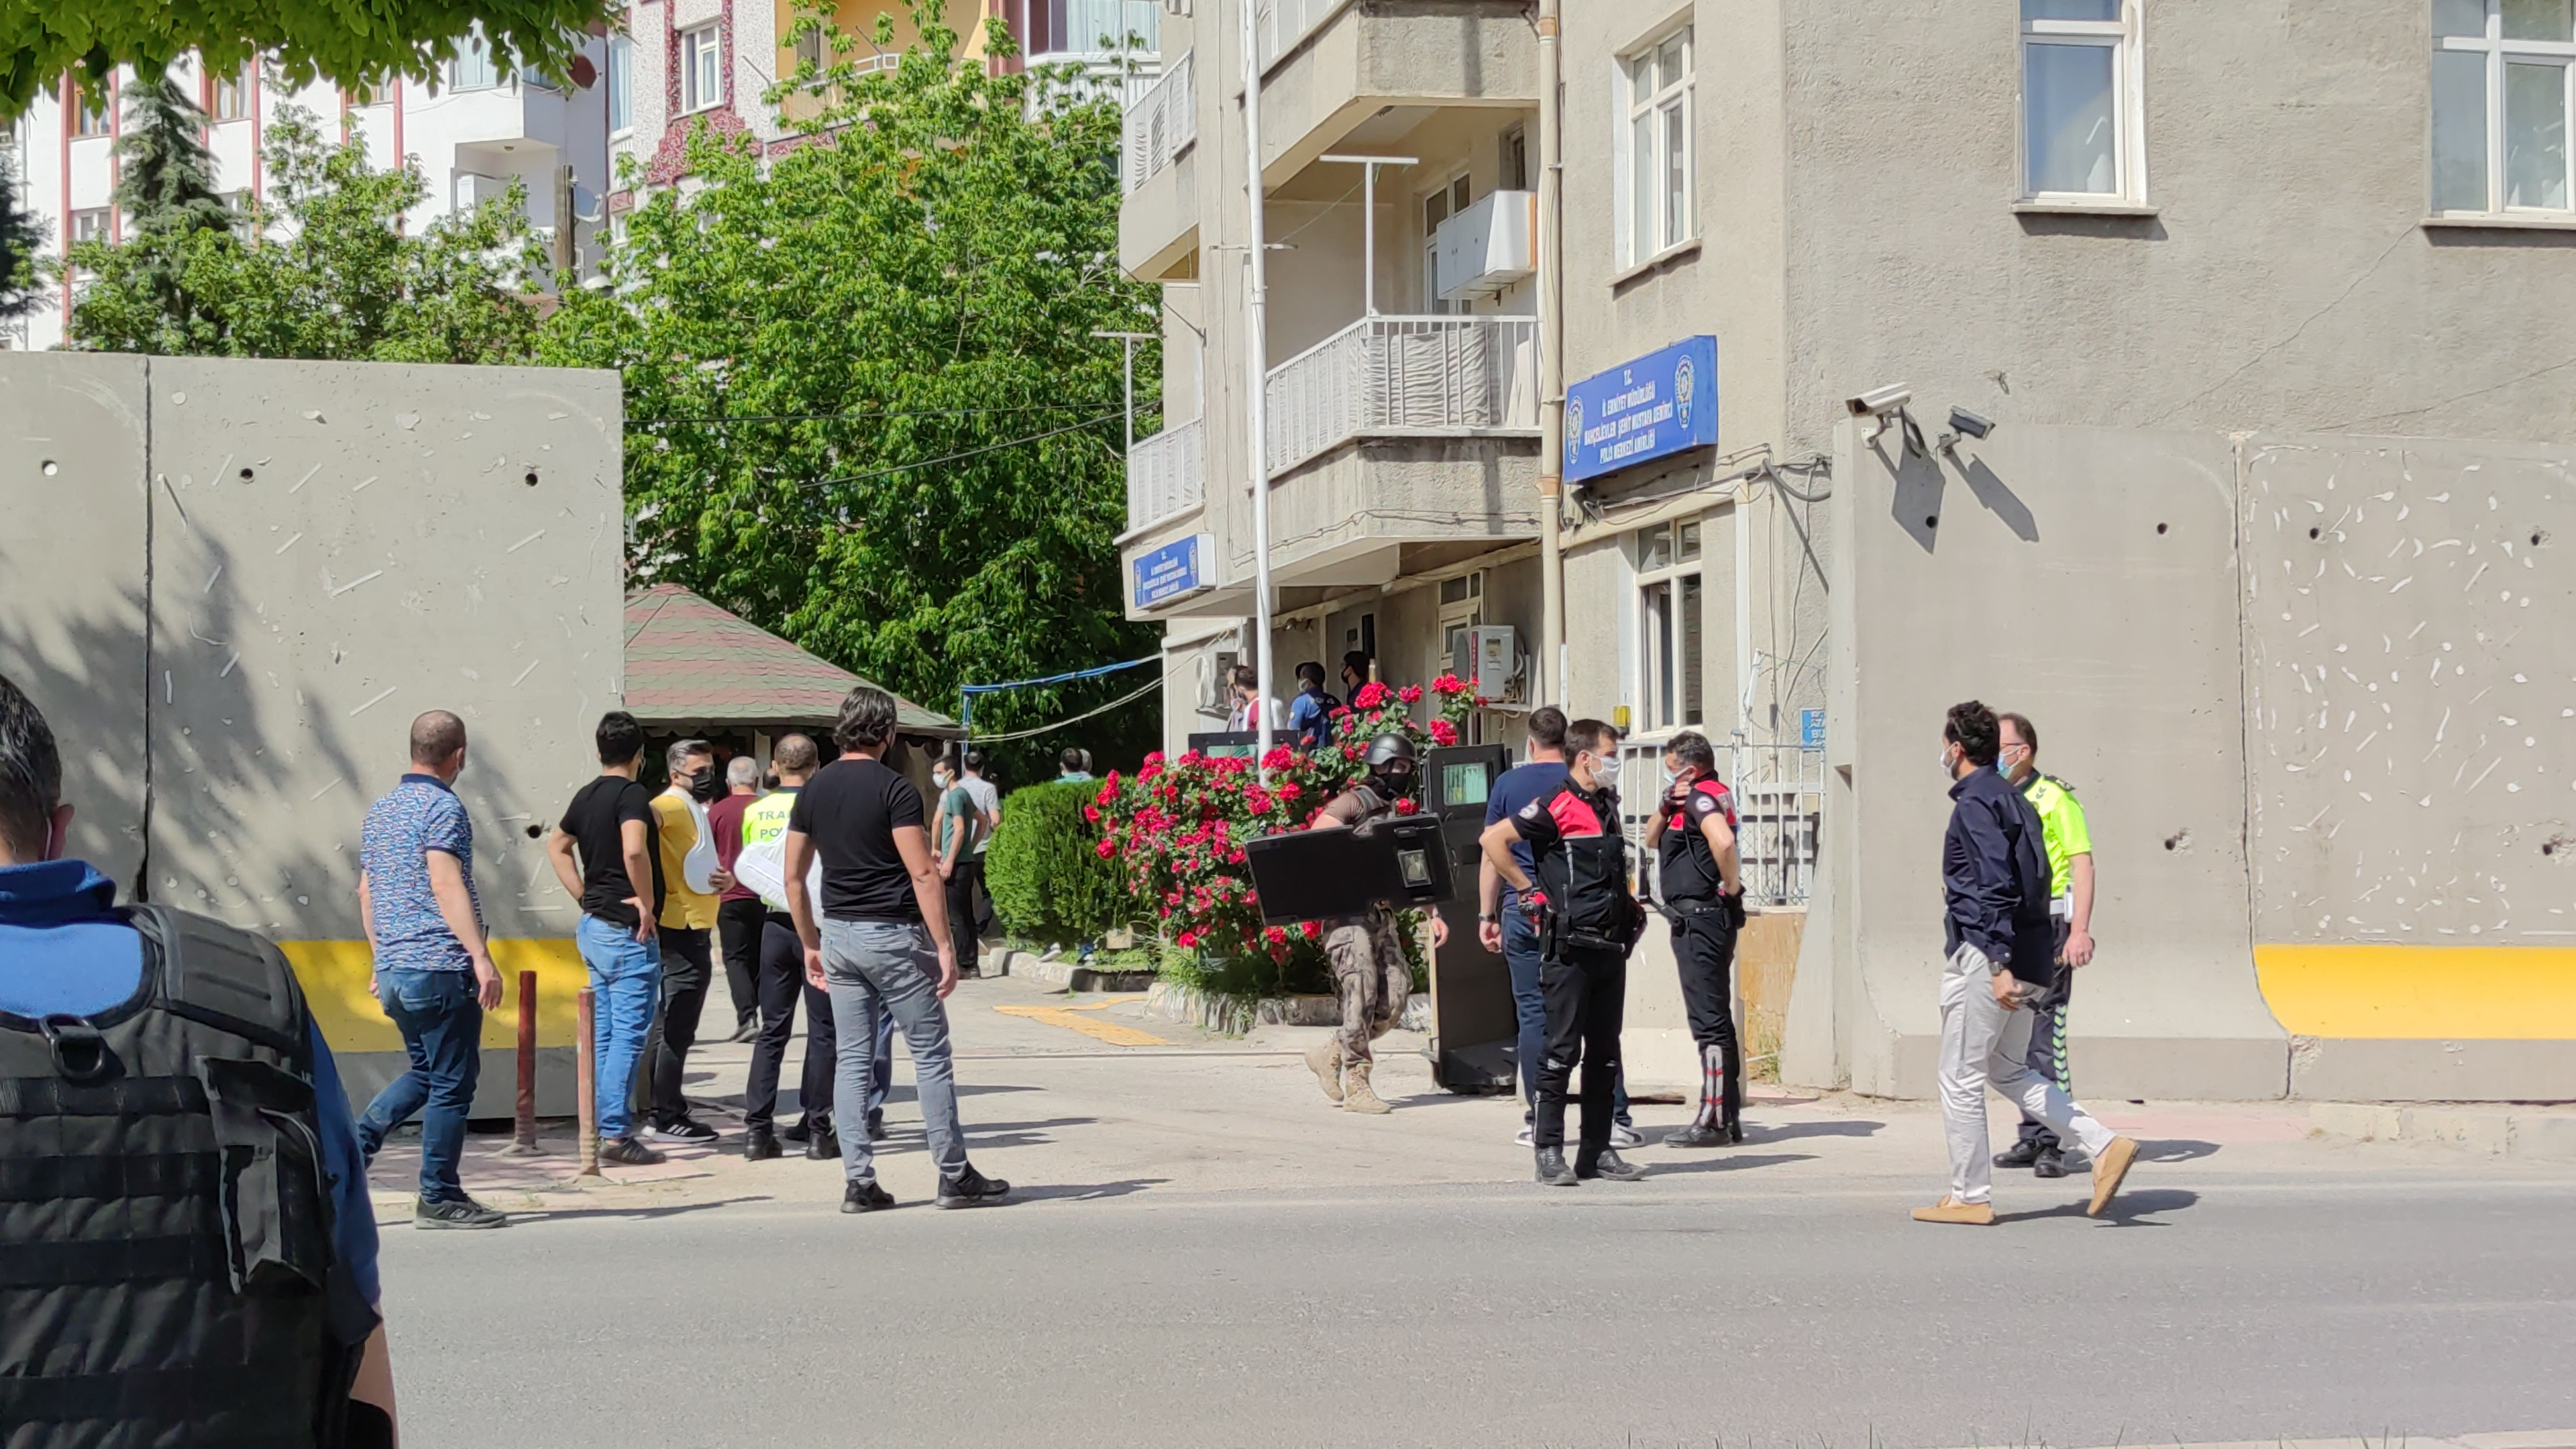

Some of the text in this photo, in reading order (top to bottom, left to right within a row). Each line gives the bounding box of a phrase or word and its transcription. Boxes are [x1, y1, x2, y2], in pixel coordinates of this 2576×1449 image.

[1607, 392, 1627, 416] EMNİYET
[1599, 442, 1613, 464] POLİS
[757, 810, 790, 821] TRA
